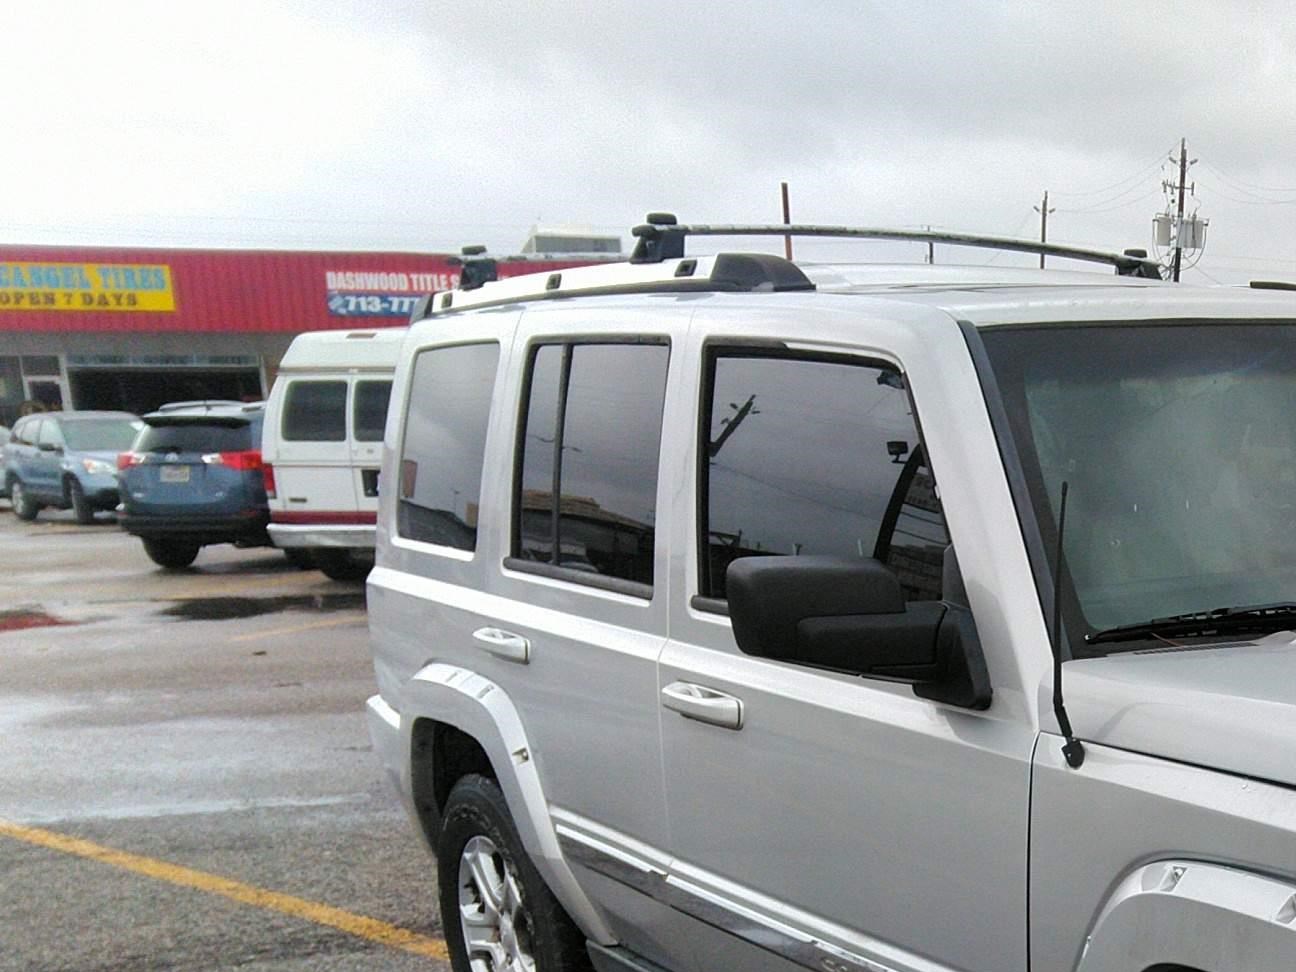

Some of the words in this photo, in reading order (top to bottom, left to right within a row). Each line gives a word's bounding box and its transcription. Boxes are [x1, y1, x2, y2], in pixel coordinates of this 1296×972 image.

[96, 267, 166, 290] TIRES
[325, 271, 408, 291] DASHWOOD
[409, 273, 448, 291] TITLE
[81, 292, 138, 307] DAYS
